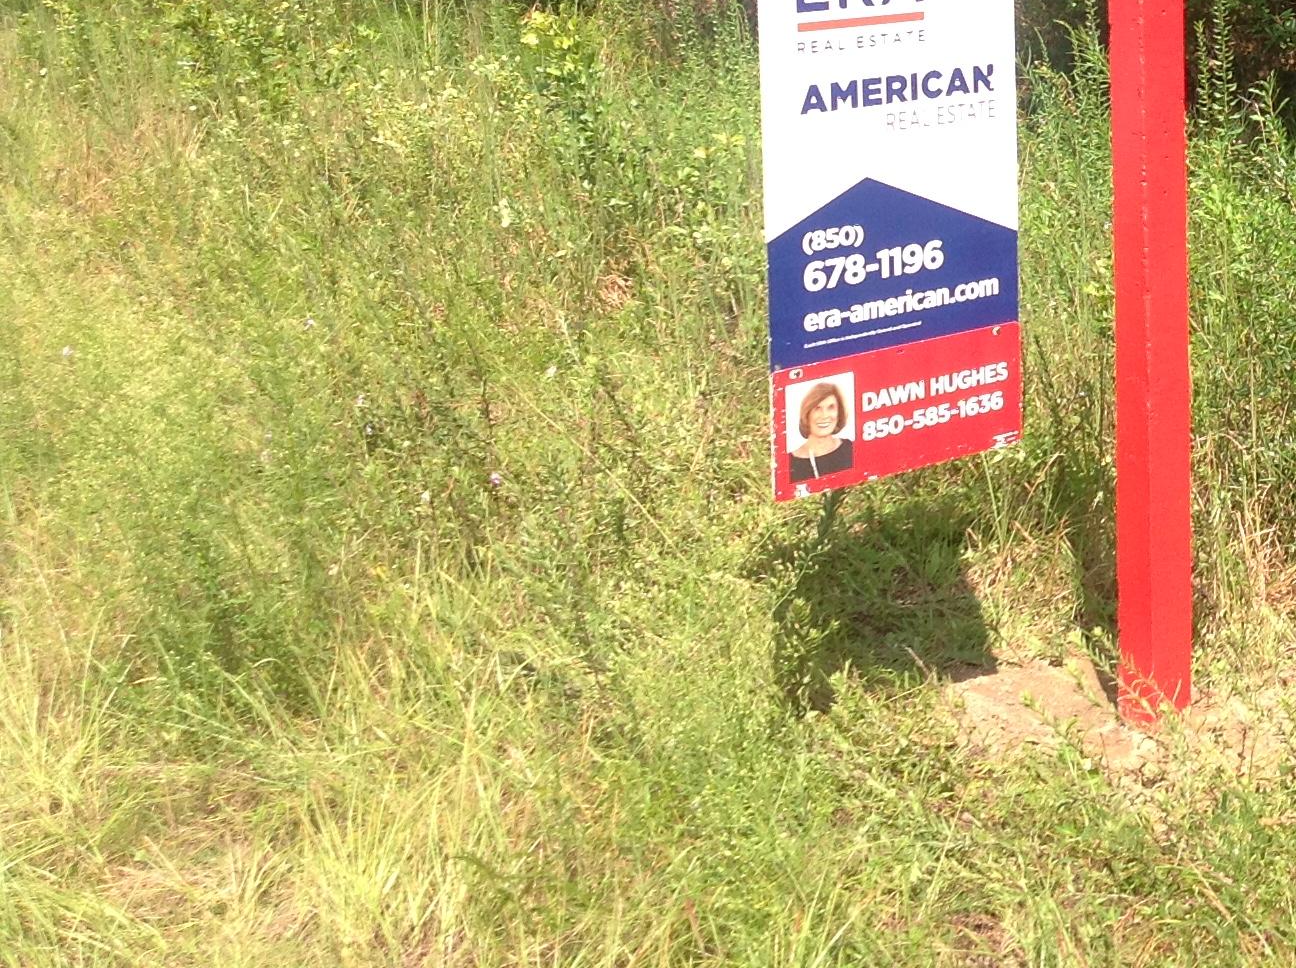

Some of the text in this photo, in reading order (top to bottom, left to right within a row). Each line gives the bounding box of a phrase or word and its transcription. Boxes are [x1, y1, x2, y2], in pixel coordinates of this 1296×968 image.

[797, 30, 926, 53] REAL ESTATE
[801, 64, 994, 115] AMERICAN
[886, 99, 996, 131] REAL ESTATE
[802, 224, 865, 255] (850)
[803, 239, 945, 292] 678-1196
[803, 277, 1000, 332] era-american.com
[862, 361, 1008, 412] DAWN HUGHES
[862, 390, 1004, 441] 850-585-1636
